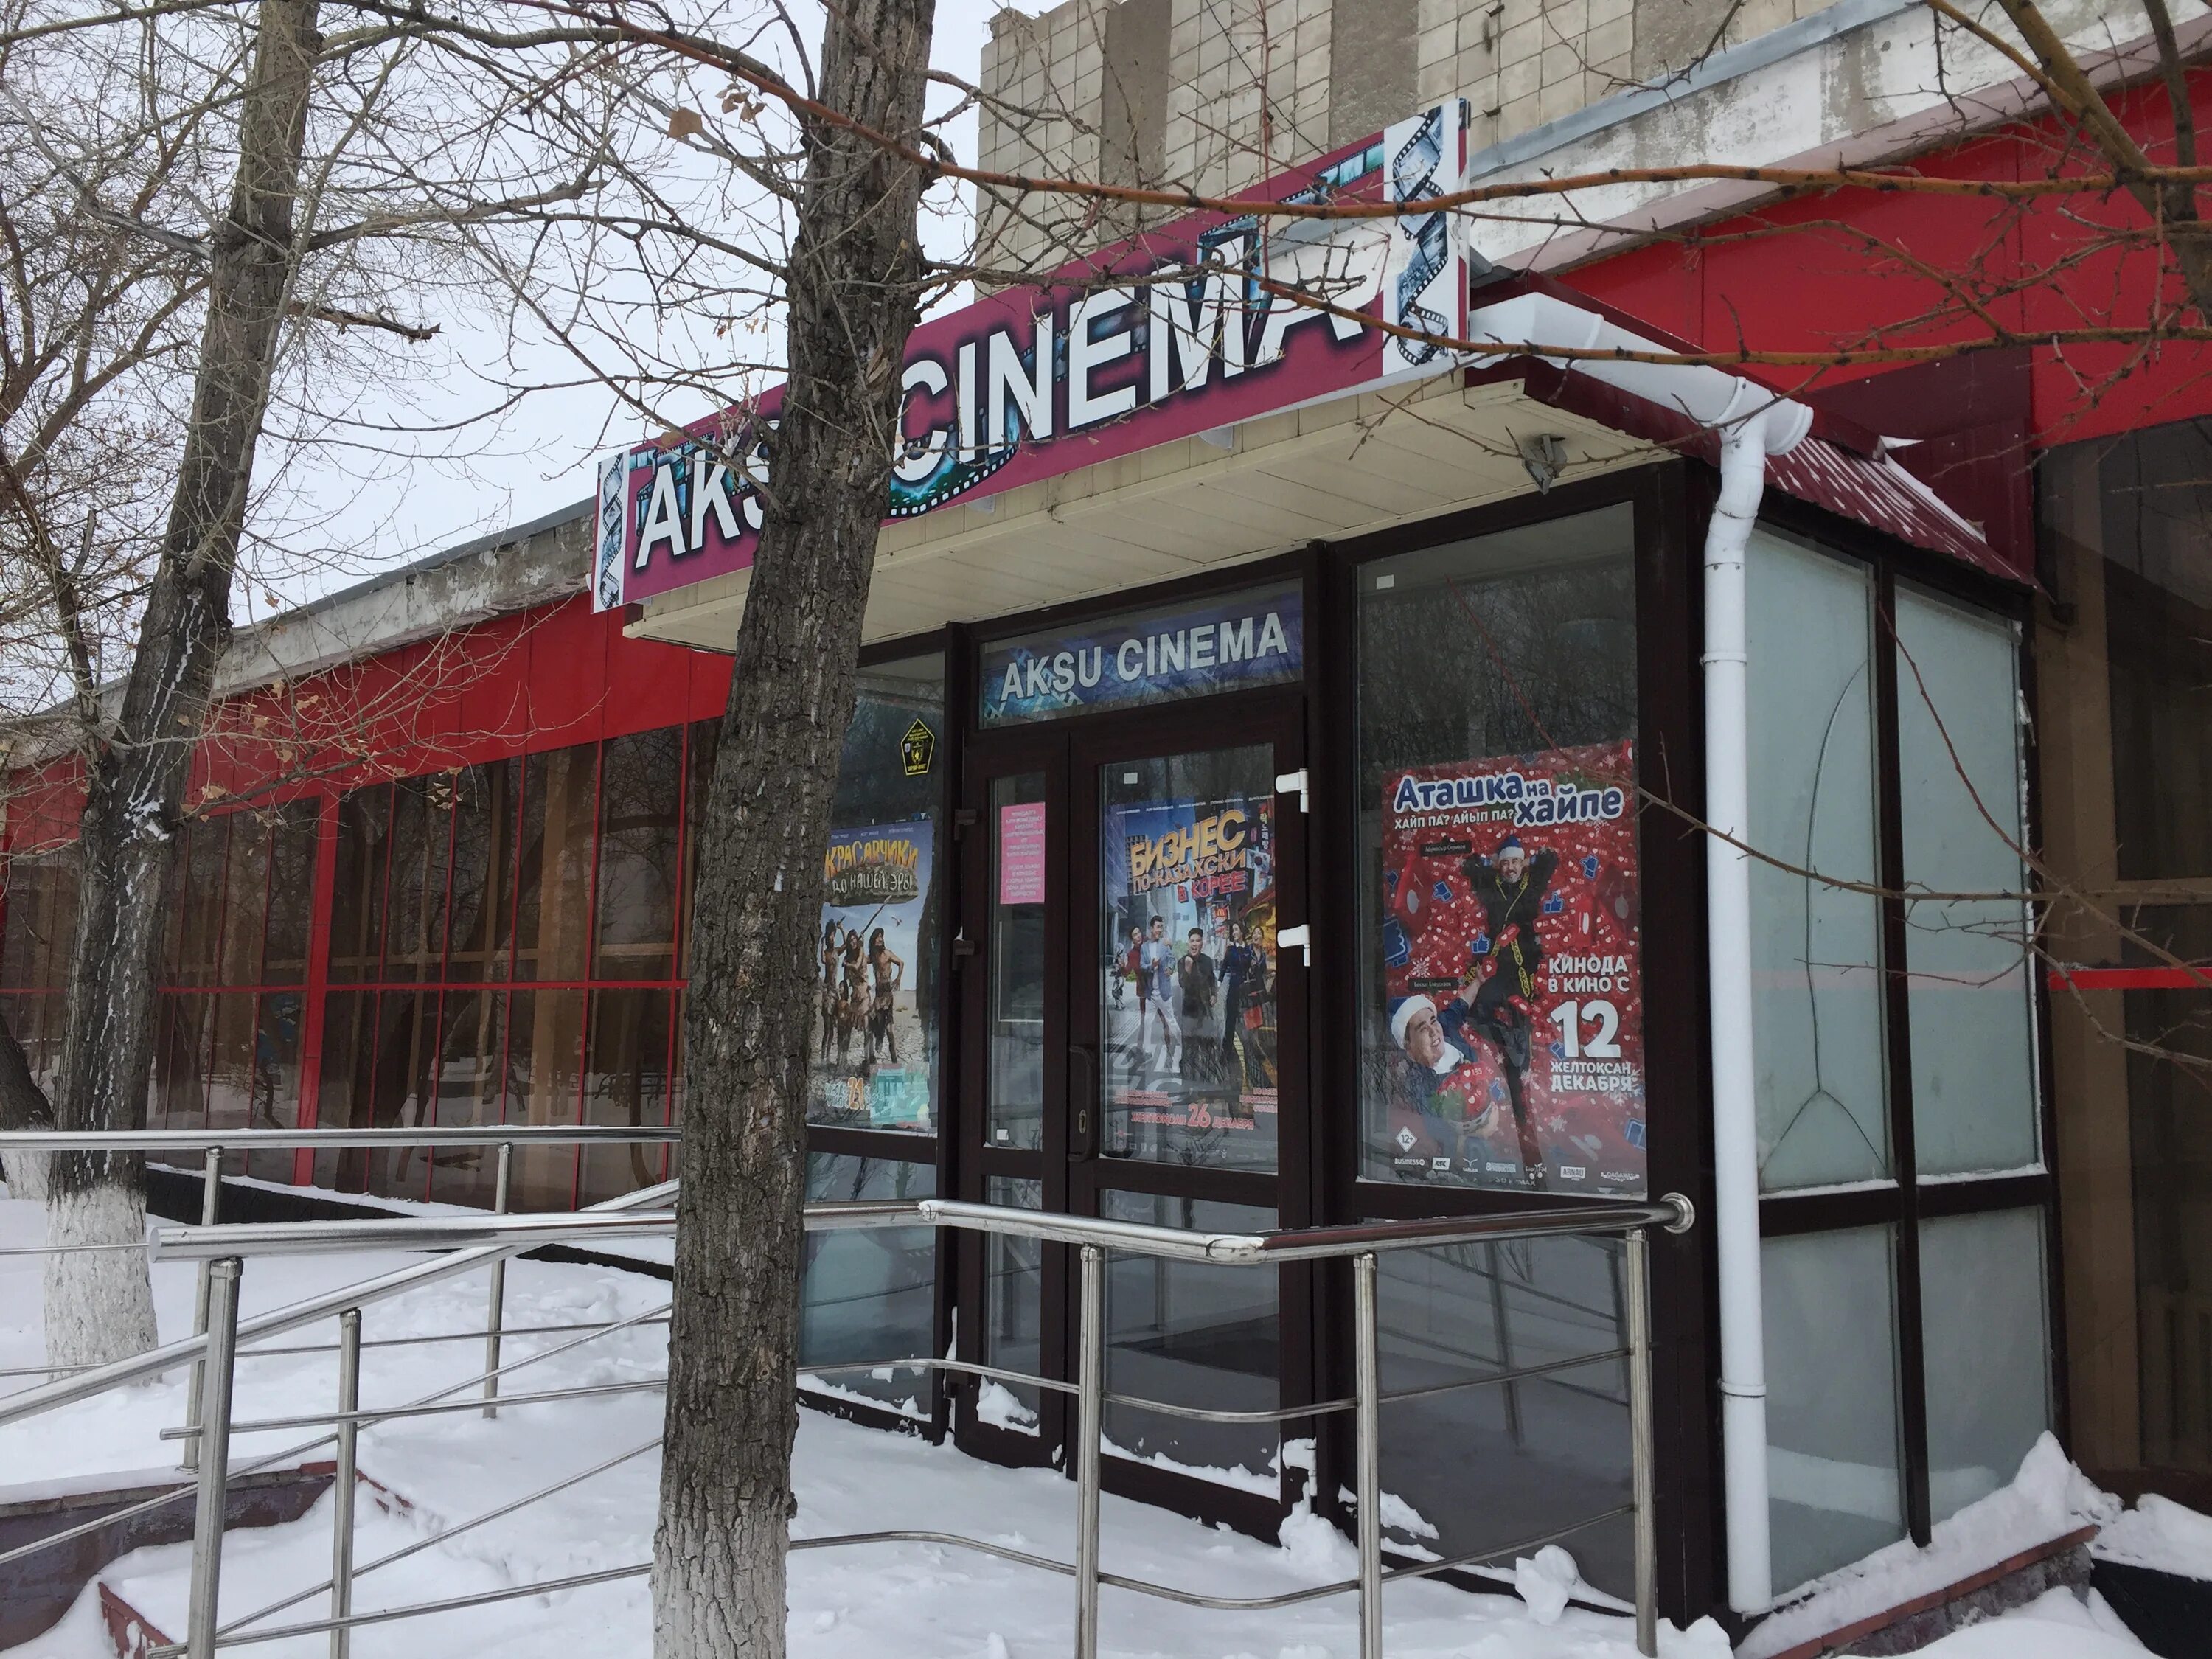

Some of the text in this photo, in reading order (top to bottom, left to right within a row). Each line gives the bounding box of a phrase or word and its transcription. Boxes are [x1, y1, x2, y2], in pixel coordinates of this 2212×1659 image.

[893, 232, 1364, 481] CINEMA
[999, 612, 1289, 702] AKSU CINEMA
[1394, 773, 1551, 813] Аташка на
[1514, 784, 1624, 828] хайпе
[1394, 809, 1514, 830] ХАЙП ПА? АЙЫП ПА?
[1130, 809, 1246, 877] БИЗНЕС
[824, 839, 919, 881] КРАСАВЧИКИ
[1133, 848, 1247, 895] ПО-КАЗАХСКИ
[832, 870, 913, 894] ДО НАШЕЙ ЭРЫ
[1177, 870, 1246, 902] В КОРЕЕ
[1548, 955, 1628, 975] КИНОДА
[1548, 976, 1630, 993] В КИНО С
[1551, 999, 1621, 1058] 12
[1551, 1062, 1632, 1075] ЖЕЛТОҚСАН
[1551, 1074, 1633, 1092] ДЕКАБРЯ
[1187, 1103, 1211, 1128] 26
[1401, 1133, 1413, 1144] 12+
